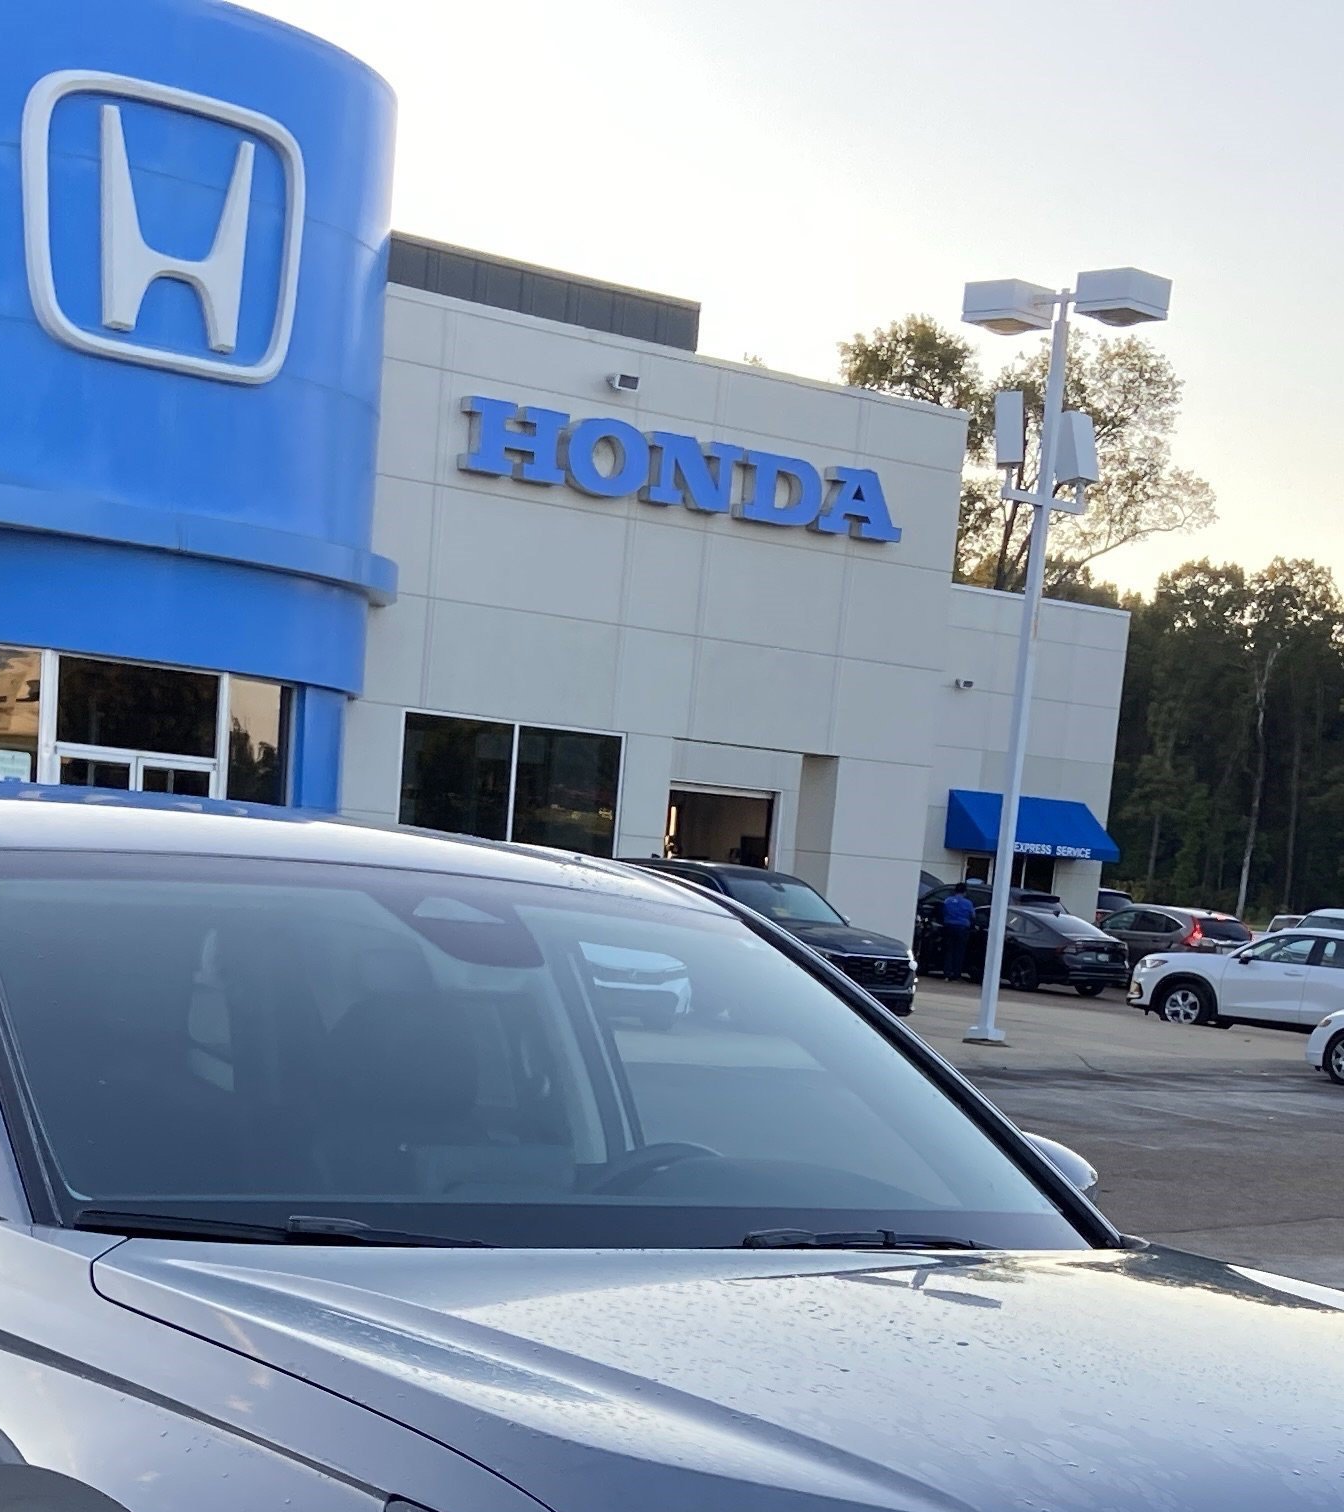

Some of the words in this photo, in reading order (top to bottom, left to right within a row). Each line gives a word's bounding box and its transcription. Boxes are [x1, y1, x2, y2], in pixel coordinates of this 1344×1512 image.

[457, 395, 902, 542] HONDA
[1013, 841, 1052, 855] EXPRESS
[1056, 845, 1091, 858] SERVICE
